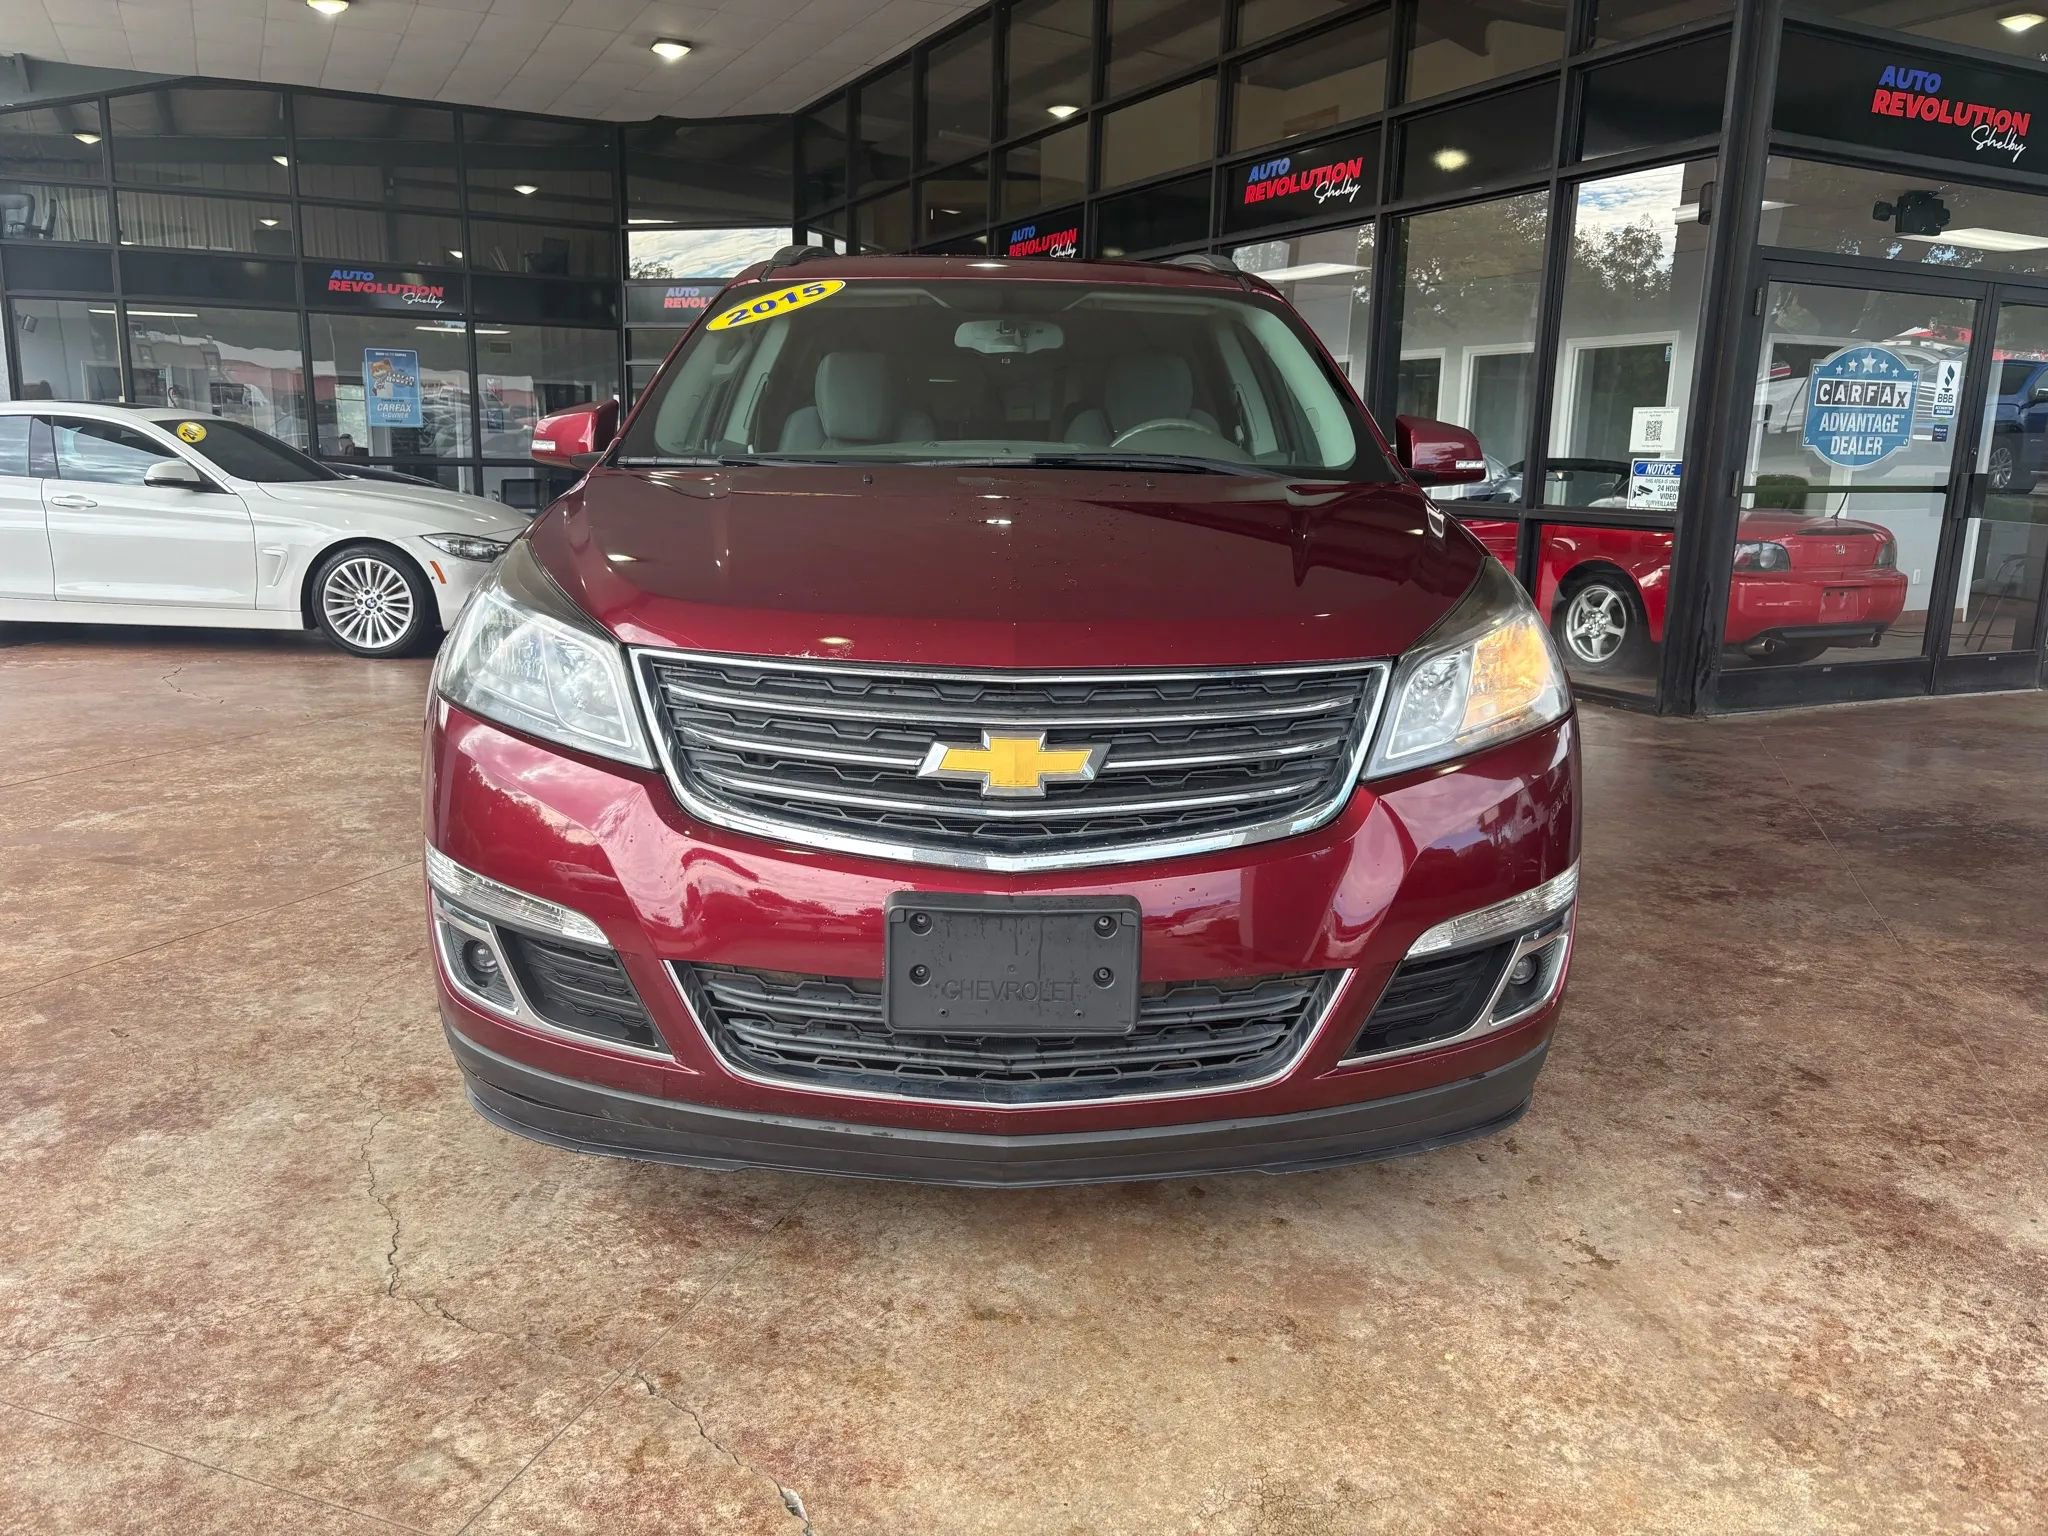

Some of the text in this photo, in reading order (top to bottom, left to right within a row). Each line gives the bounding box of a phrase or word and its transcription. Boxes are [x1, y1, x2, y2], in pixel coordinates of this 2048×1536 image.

[1878, 65, 1942, 94] AUTO
[1871, 88, 2031, 137] REVOLUTION
[1970, 124, 2027, 163] Shelby
[1244, 157, 1363, 204] REVOLUTION
[1248, 157, 1291, 183] AUTO
[1314, 174, 1361, 204] Shelby
[1009, 228, 1078, 256] REVOLUTION
[1010, 225, 1036, 243] AUTO
[330, 269, 374, 280] AUTO
[328, 279, 446, 297] REVOLUTION
[666, 287, 700, 297] AUTO
[402, 292, 445, 308] Shelby
[664, 296, 713, 308] REVOL
[726, 283, 826, 325] 2015
[1819, 383, 1908, 407] CARFAX
[1937, 393, 1954, 403] BBB
[377, 403, 412, 412] CARFAX
[1819, 412, 1900, 433] ADVANTAGE
[1830, 436, 1883, 455] DEALER
[1645, 463, 1677, 475] NOTICE
[942, 980, 1080, 1001] CHEVROLET
